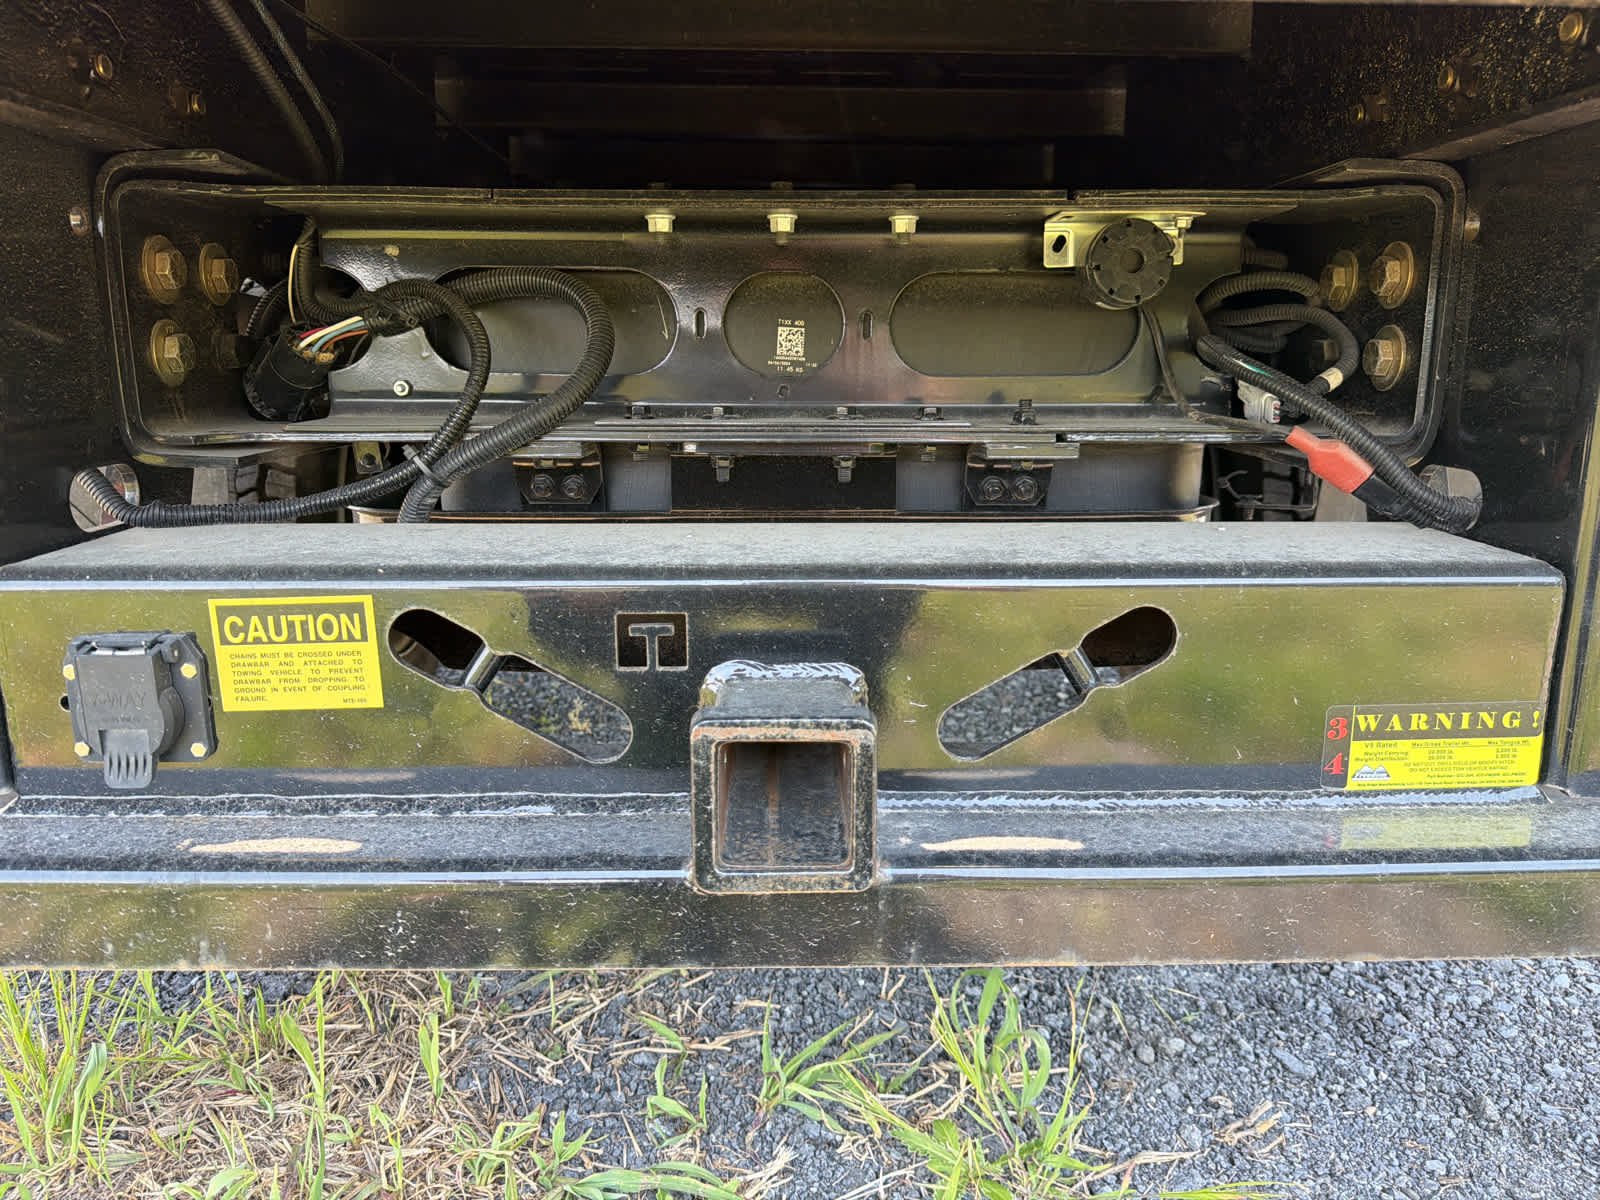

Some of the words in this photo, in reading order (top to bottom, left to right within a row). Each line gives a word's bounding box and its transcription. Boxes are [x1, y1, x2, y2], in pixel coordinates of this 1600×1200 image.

[223, 613, 362, 644] CAUTION
[229, 652, 257, 660] CHAINS
[297, 650, 333, 658] CROSSED
[230, 661, 270, 669] DRAWBAR
[307, 676, 347, 684] DROPPING
[354, 675, 365, 683] TO
[234, 686, 266, 694] GROUND
[283, 685, 307, 693] EVENT
[327, 683, 366, 691] COUPLING
[1327, 716, 1349, 741] 3
[1323, 752, 1345, 776] 4
